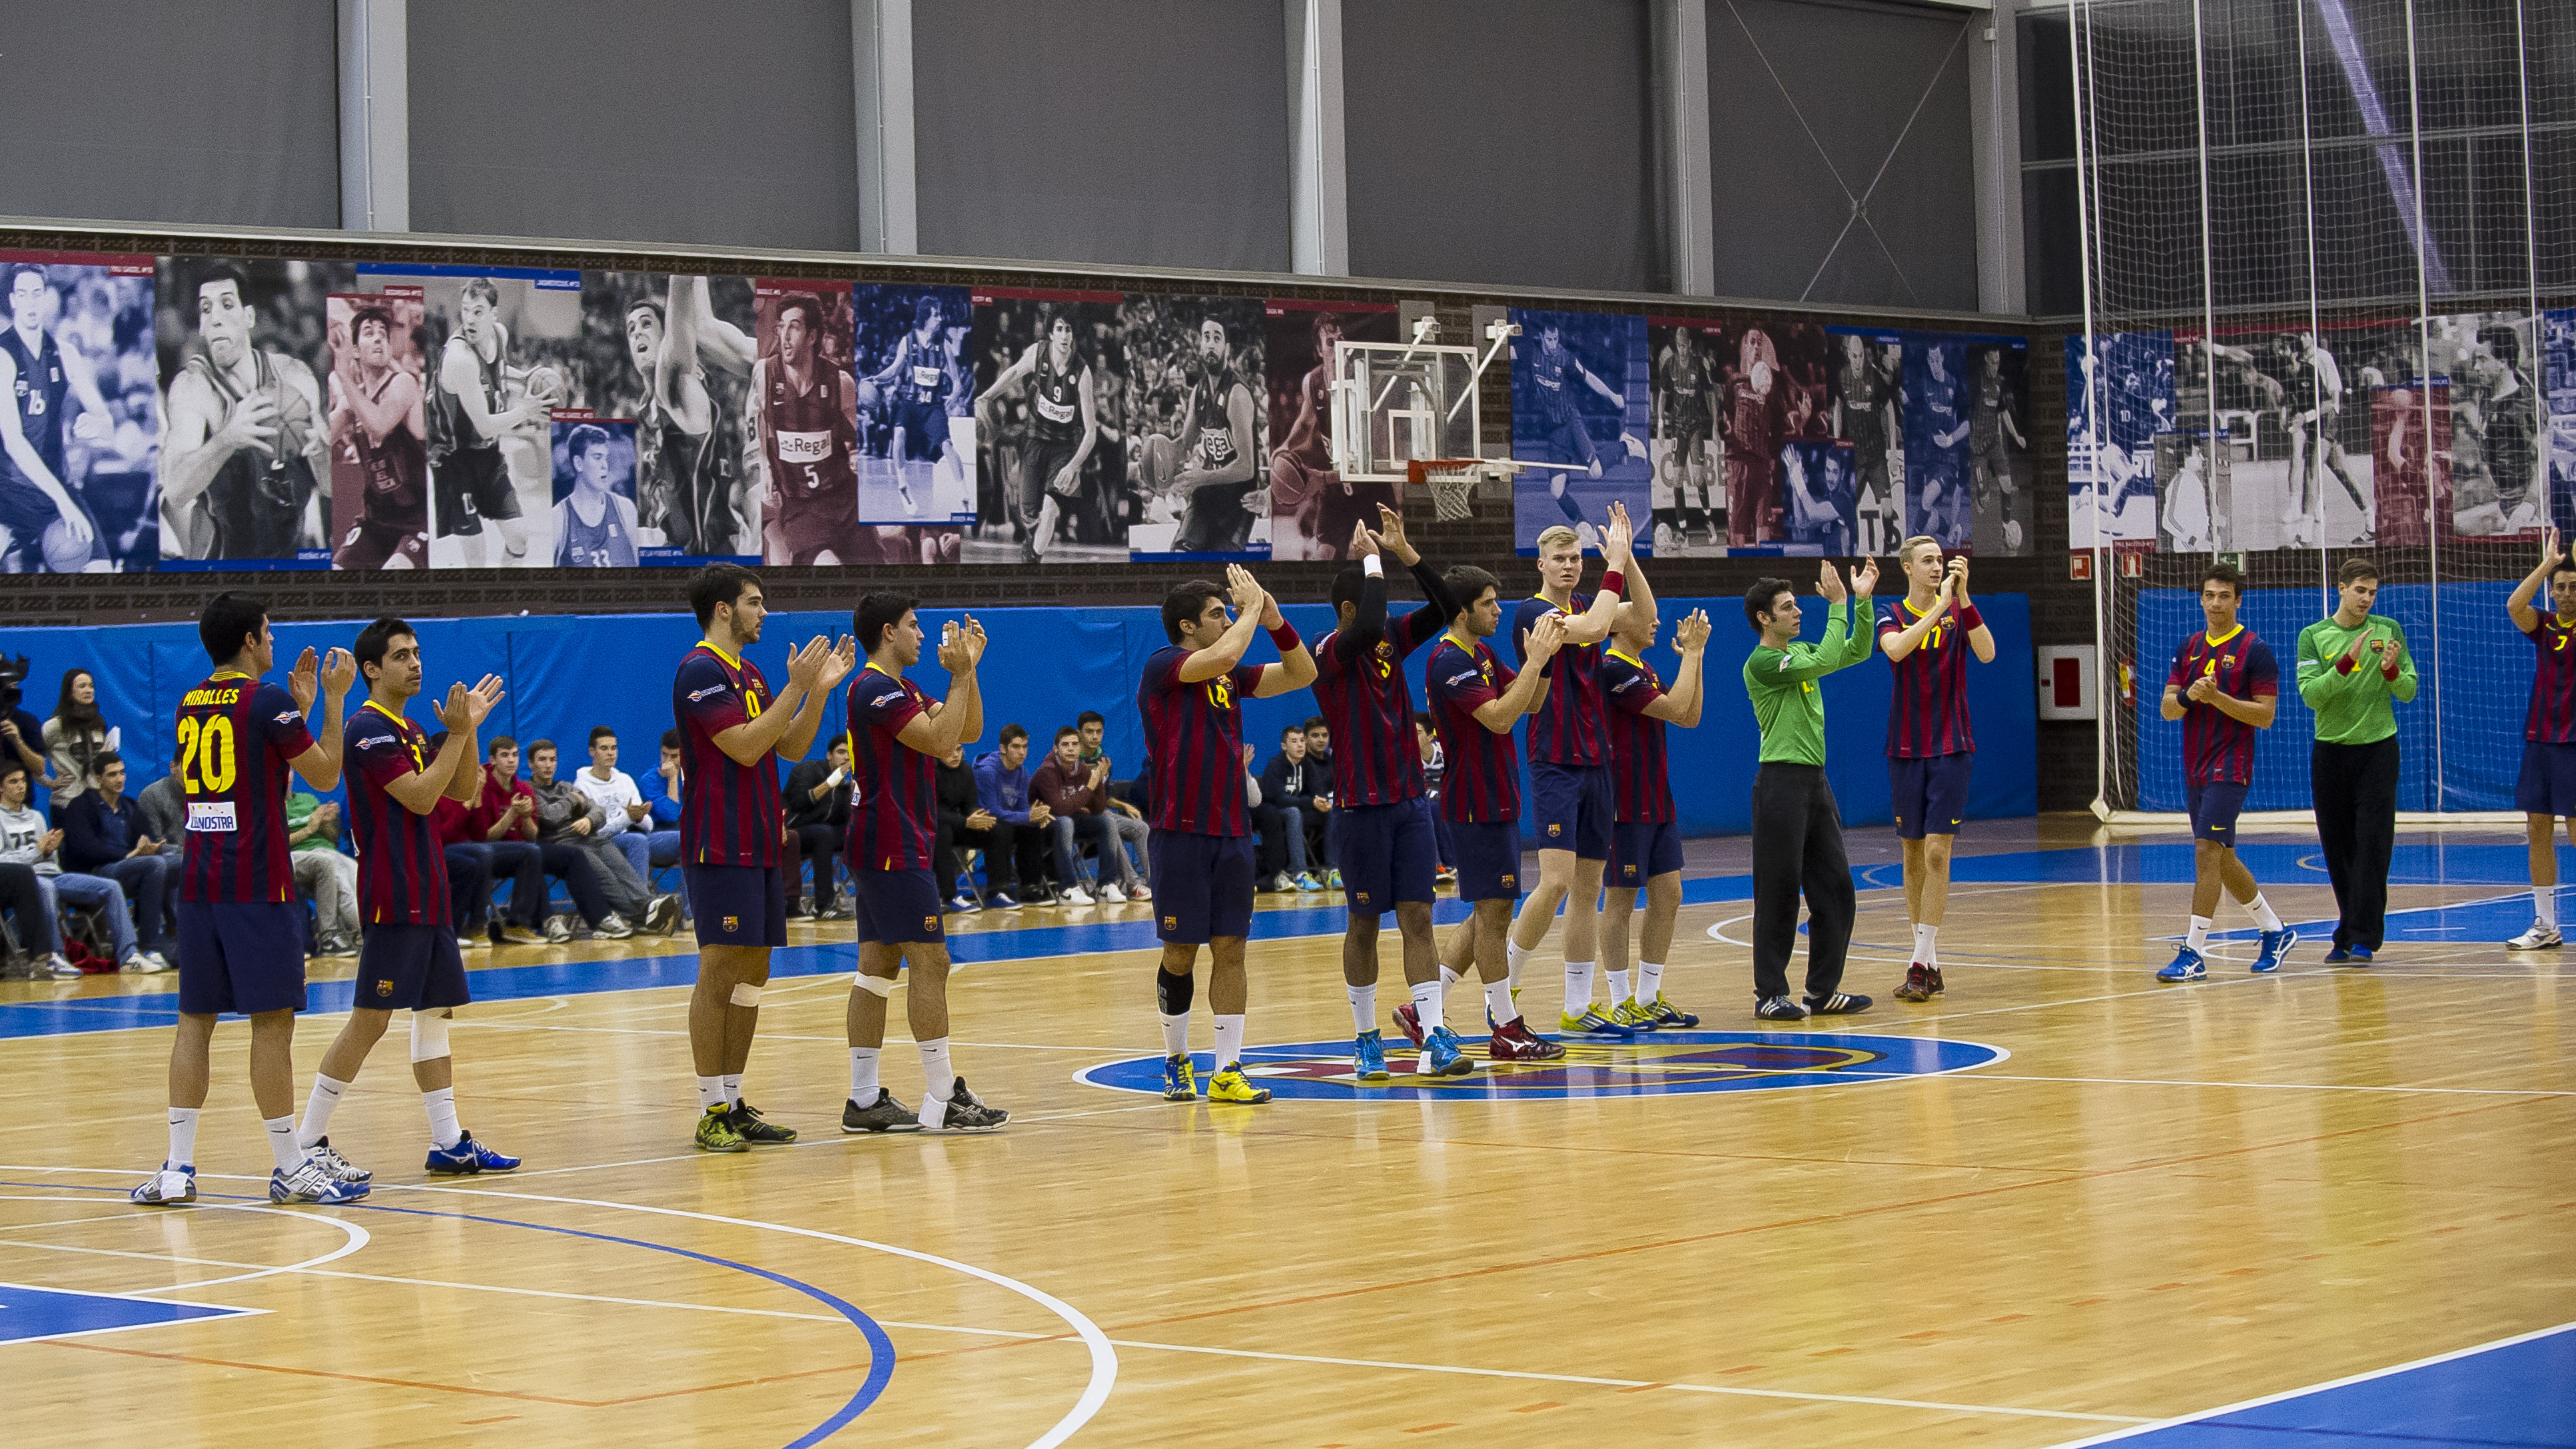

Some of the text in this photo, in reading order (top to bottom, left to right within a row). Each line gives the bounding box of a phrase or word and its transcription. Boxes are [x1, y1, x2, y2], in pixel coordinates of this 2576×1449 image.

[1054, 386, 1061, 402] 9
[804, 464, 819, 488] 5
[2554, 635, 2568, 651] 7
[2204, 658, 2216, 675] 4
[183, 689, 239, 706] MIRALLES
[178, 714, 236, 794] 20
